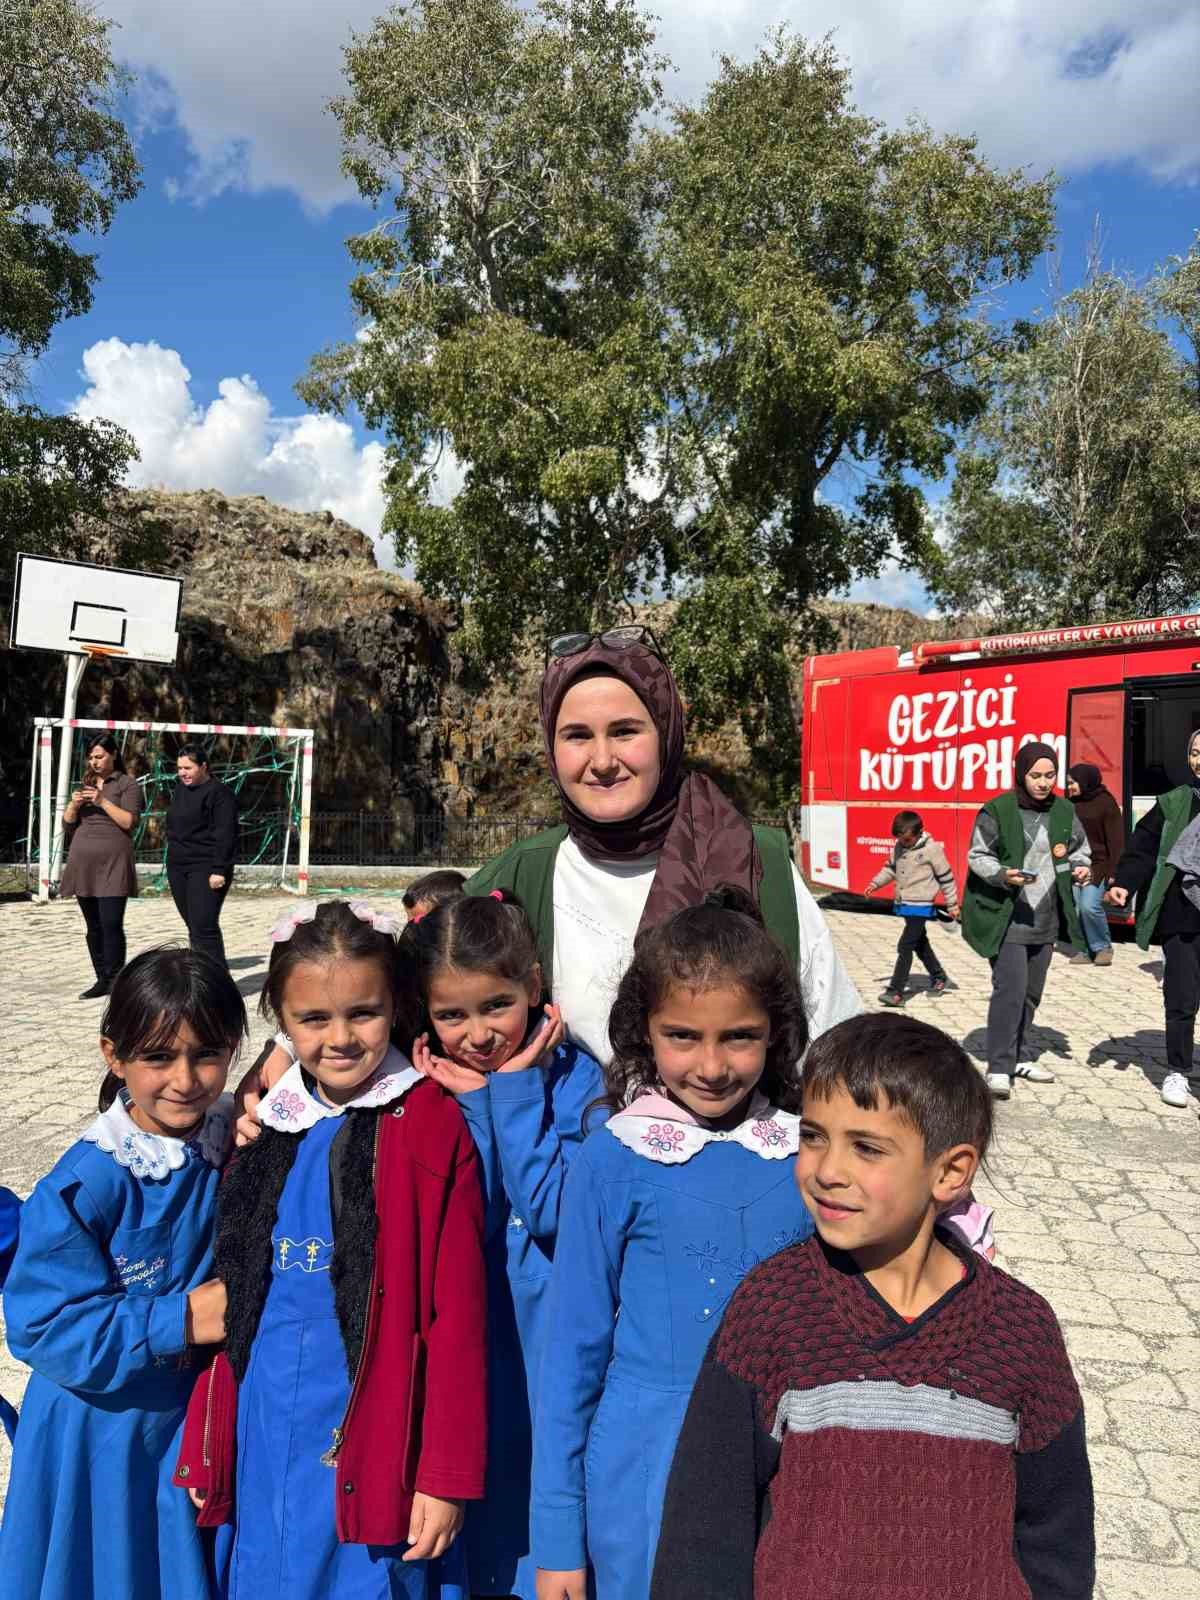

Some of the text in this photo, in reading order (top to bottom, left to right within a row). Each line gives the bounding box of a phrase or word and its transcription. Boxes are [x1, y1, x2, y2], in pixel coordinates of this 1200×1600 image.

[980, 630, 1081, 650] KÜTÜPHANELER
[1083, 628, 1101, 641] VE
[1104, 620, 1181, 638] YAYIMLAR
[888, 673, 1018, 746] GEZİCİ
[860, 733, 1067, 791] KÜTÜPHN
